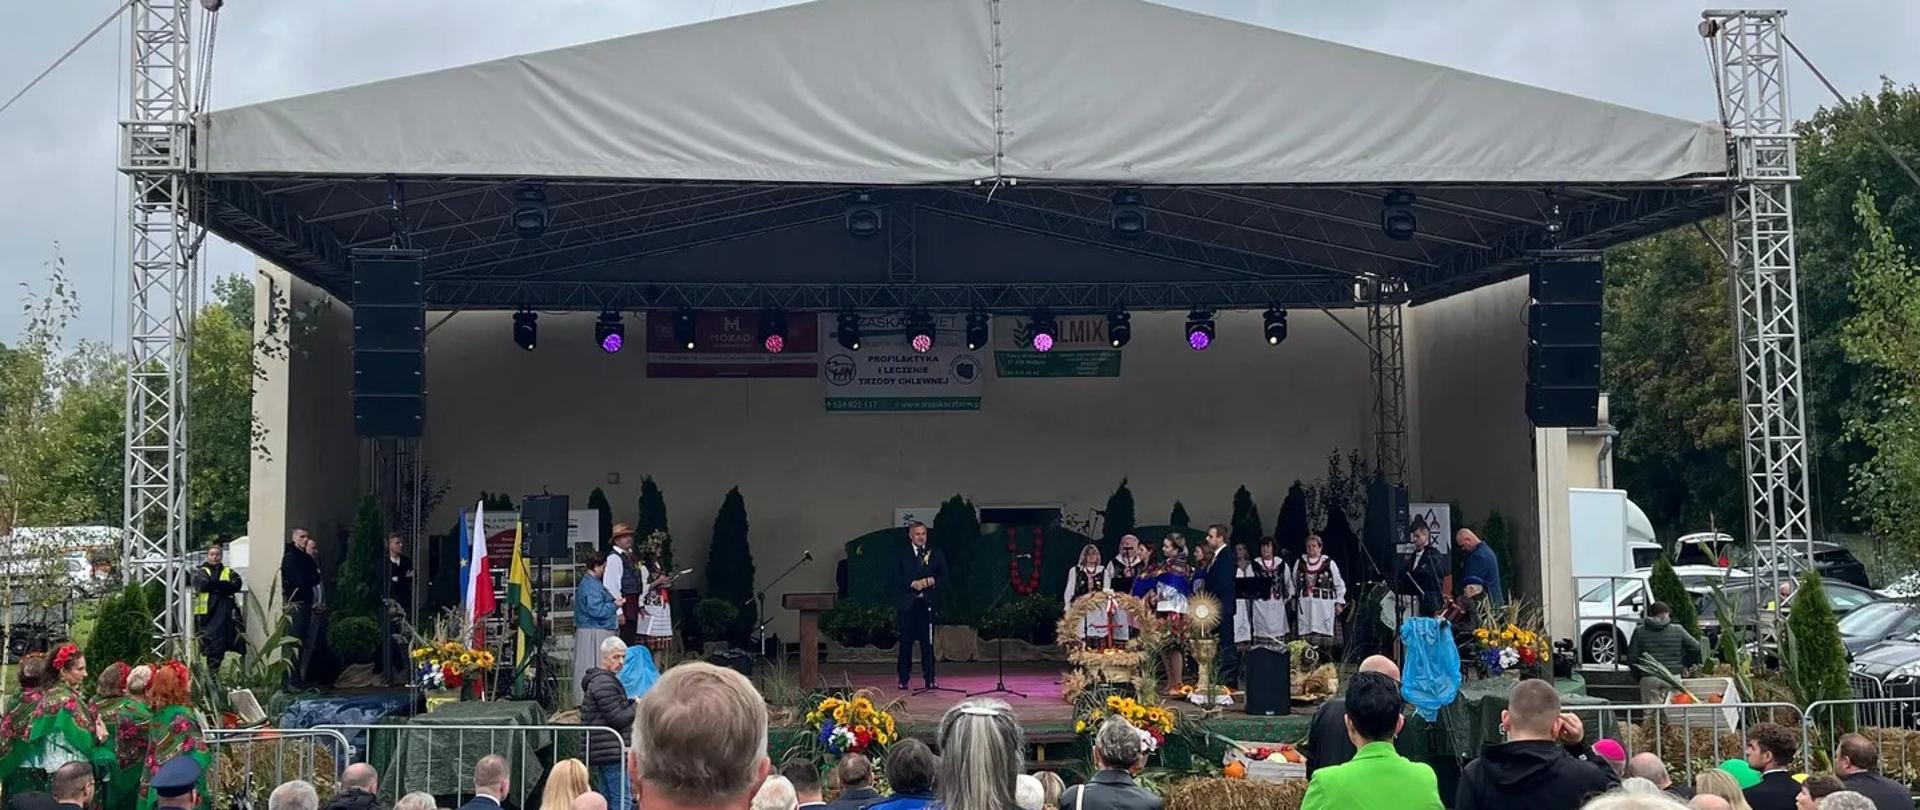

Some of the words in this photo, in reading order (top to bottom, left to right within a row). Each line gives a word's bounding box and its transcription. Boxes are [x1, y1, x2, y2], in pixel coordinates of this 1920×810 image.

[867, 354, 940, 363] PROFILAKTYKA
[884, 366, 929, 374] LECZENIE
[858, 377, 896, 385] TRZODY
[898, 377, 949, 385] CHLEWNEJ
